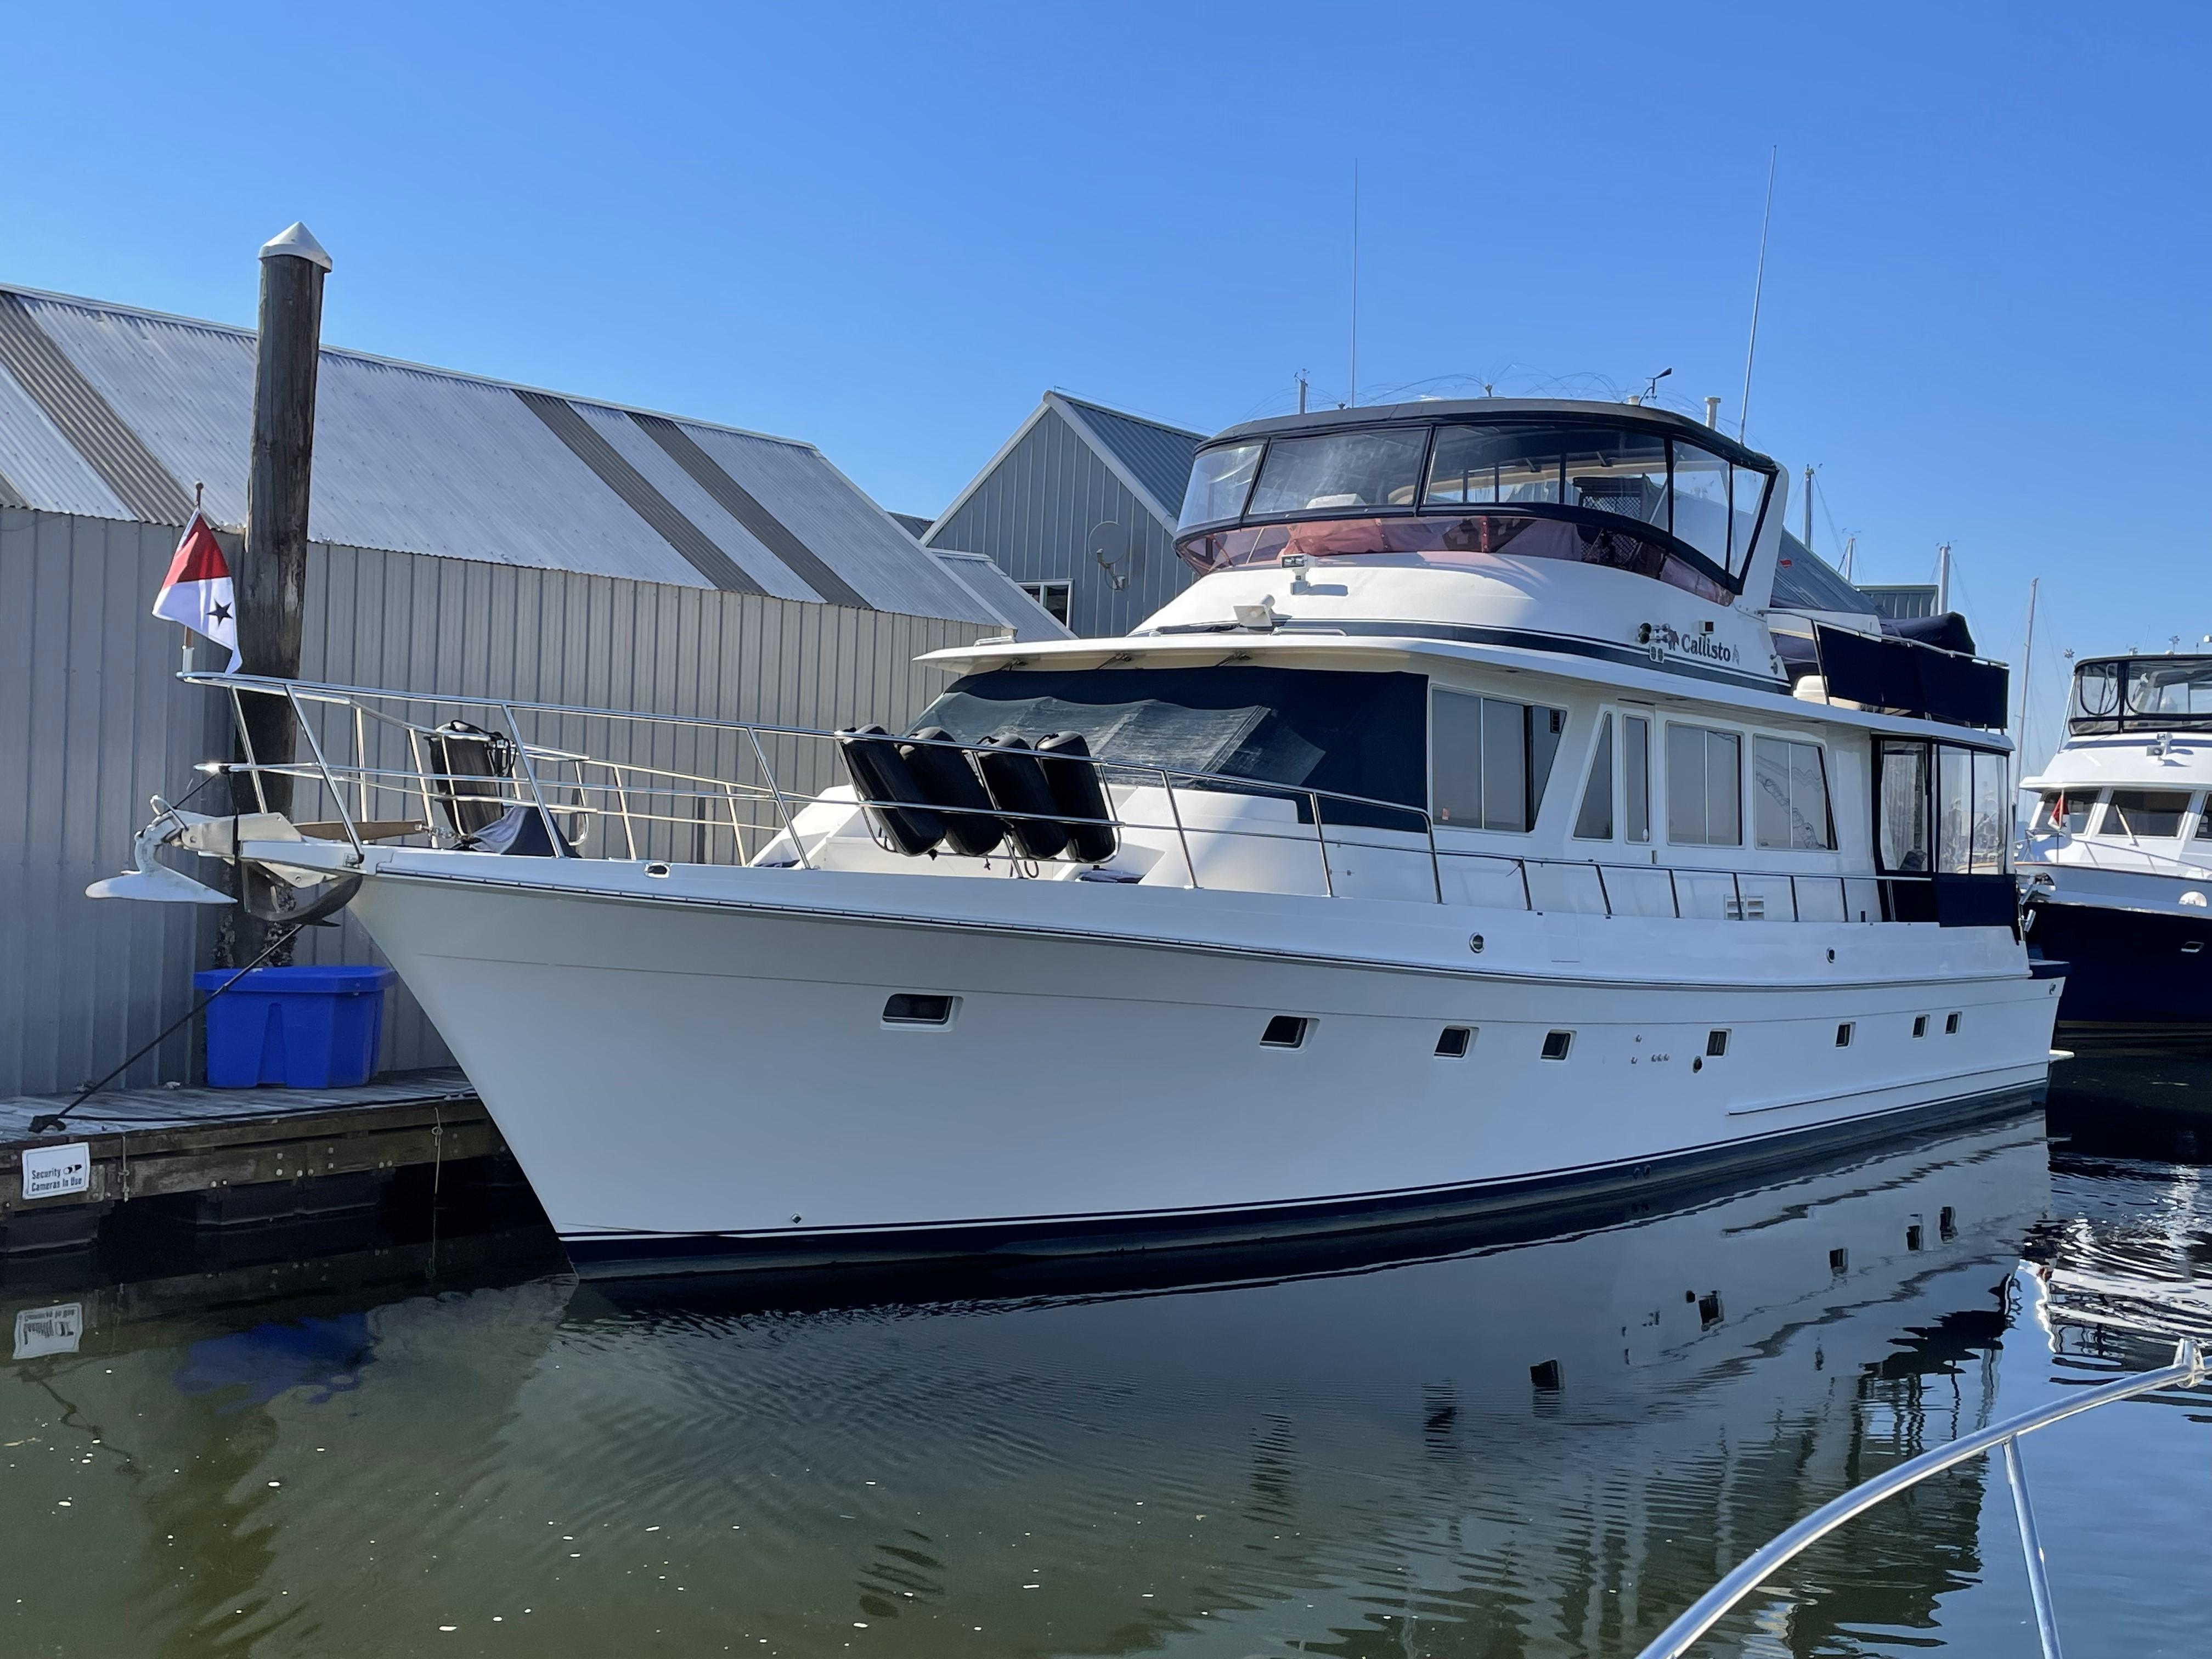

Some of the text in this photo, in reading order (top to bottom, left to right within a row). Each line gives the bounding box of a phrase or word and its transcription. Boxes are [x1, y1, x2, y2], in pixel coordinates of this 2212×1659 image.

[1681, 634, 1730, 662] Callisto
[32, 1167, 61, 1180] Security
[32, 1176, 82, 1192] Cameras In Use
